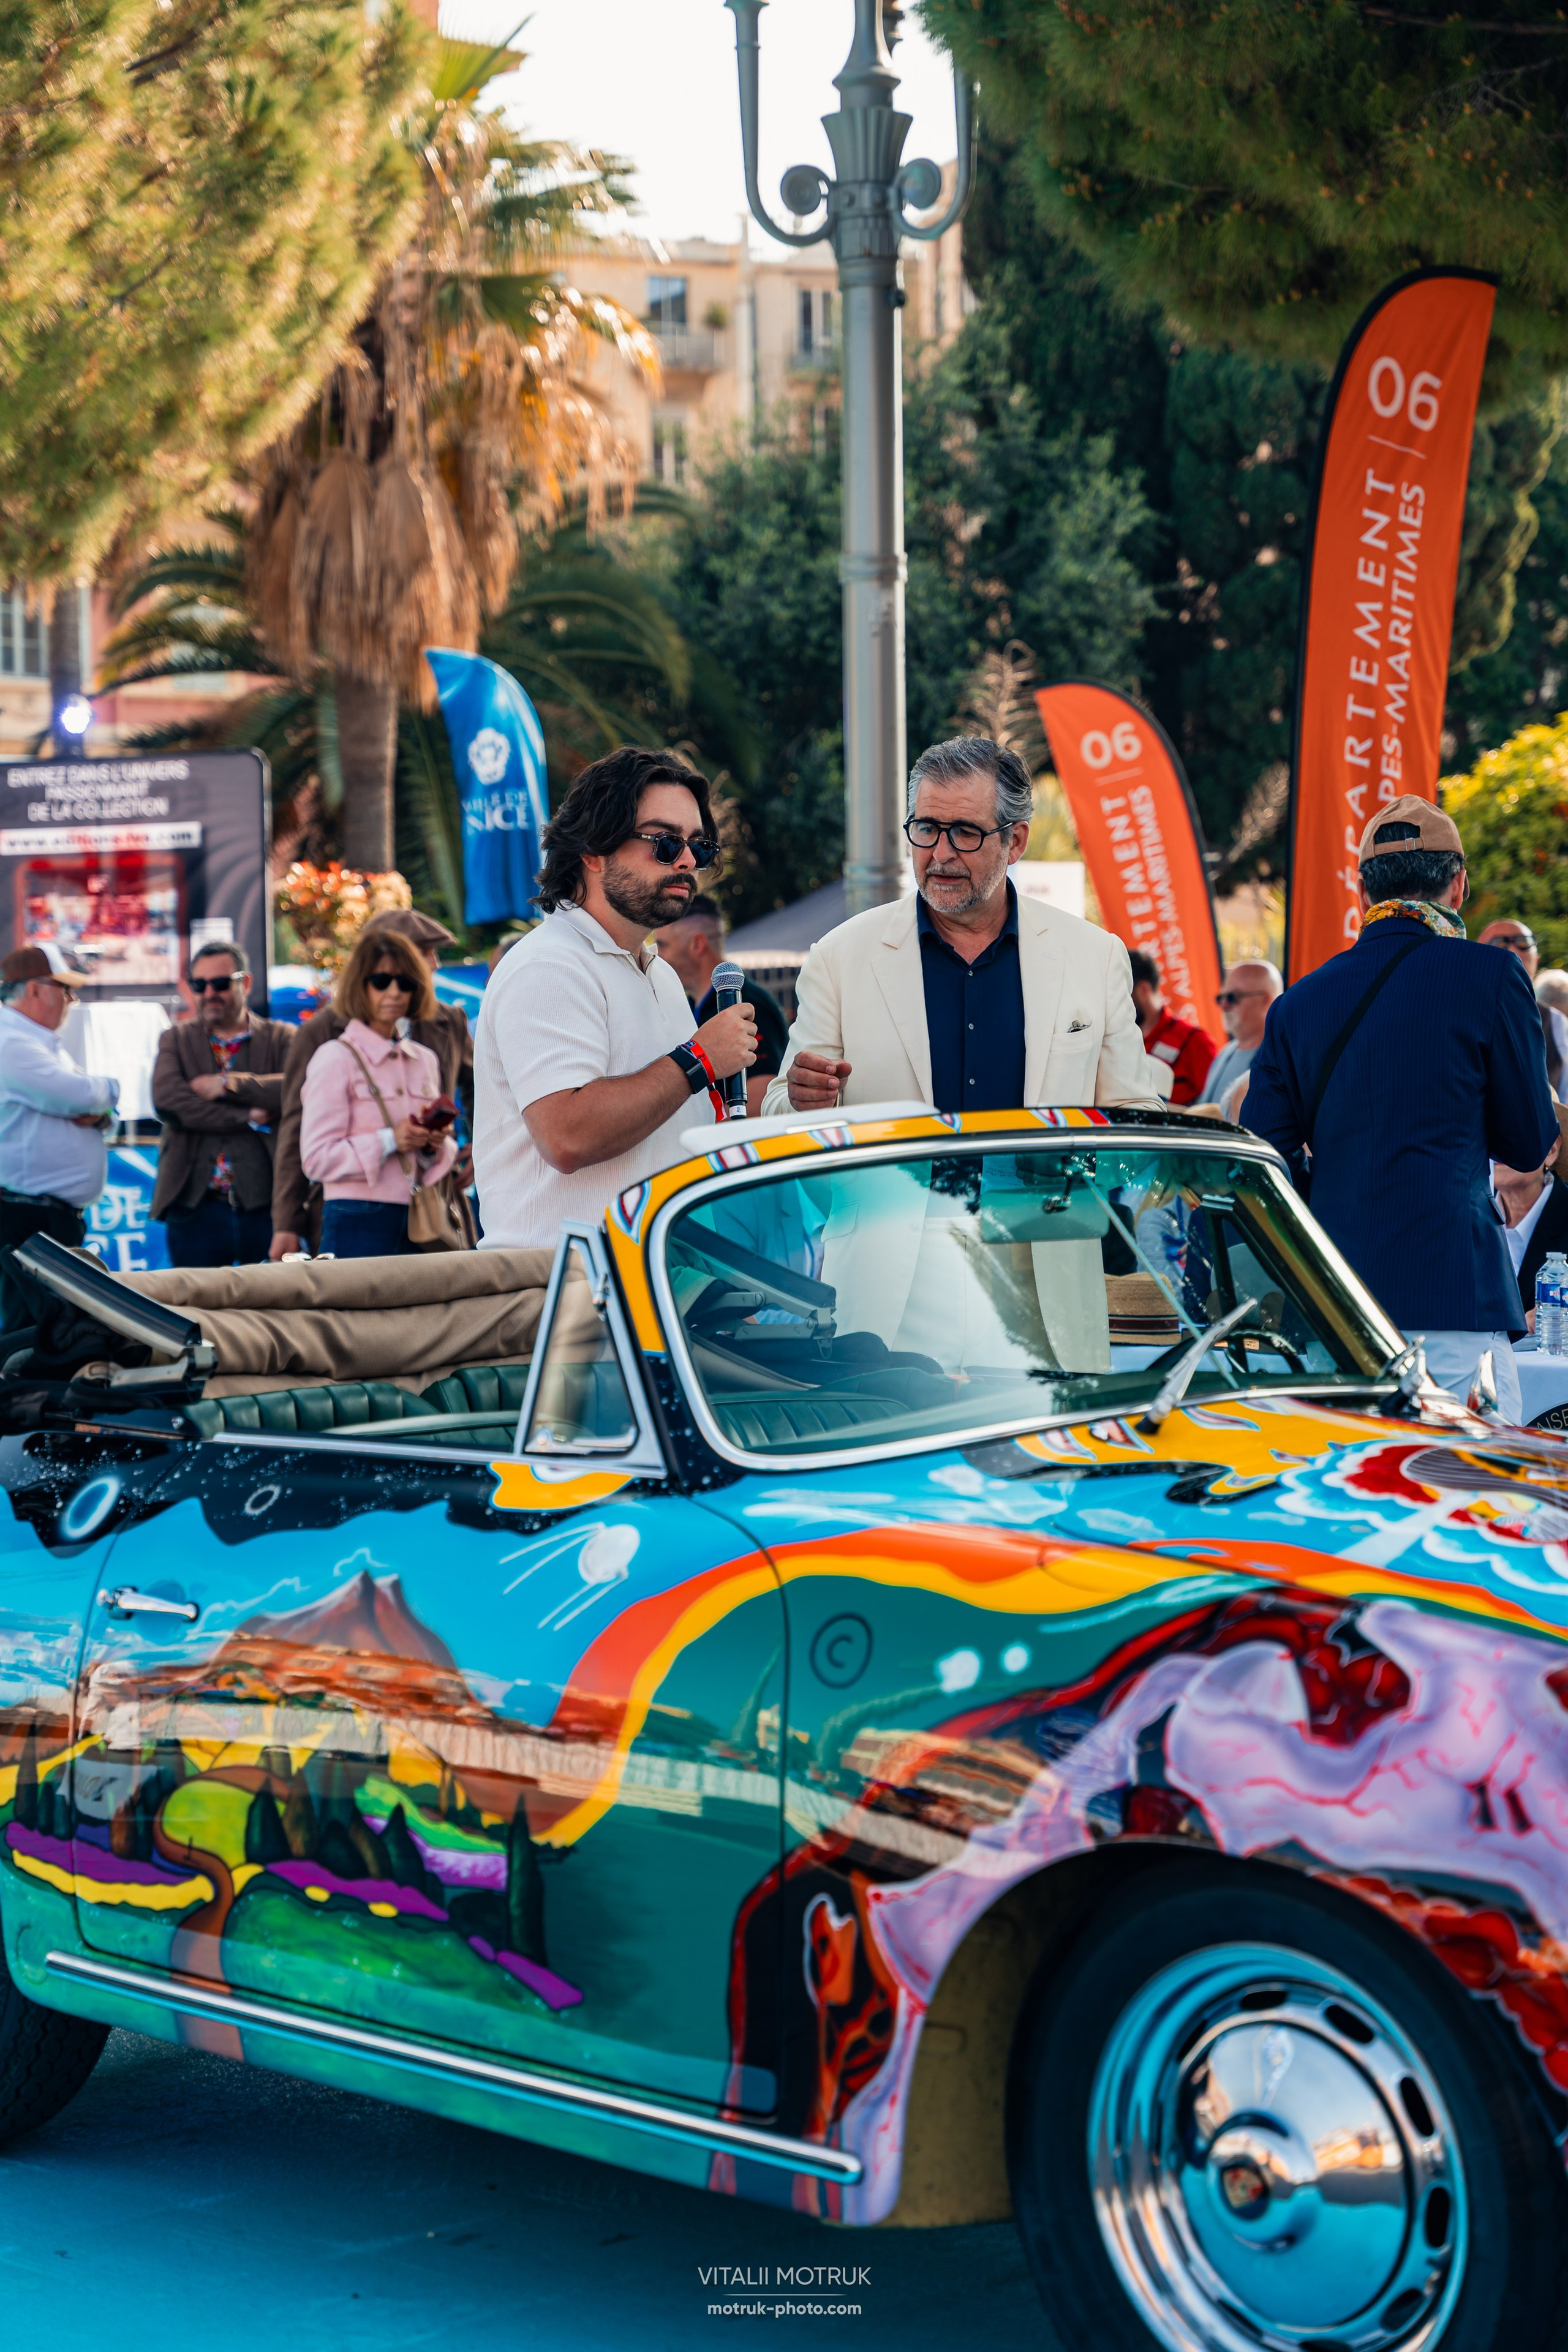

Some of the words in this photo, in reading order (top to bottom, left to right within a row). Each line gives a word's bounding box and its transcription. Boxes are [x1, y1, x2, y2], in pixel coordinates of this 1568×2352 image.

[1367, 355, 1442, 432] 06
[1377, 481, 1425, 804] PES-MARITIMES
[1080, 721, 1142, 769] 06
[7, 766, 67, 788] ENTREZ
[73, 796, 169, 820] COLLECTION
[466, 805, 530, 836] NICE
